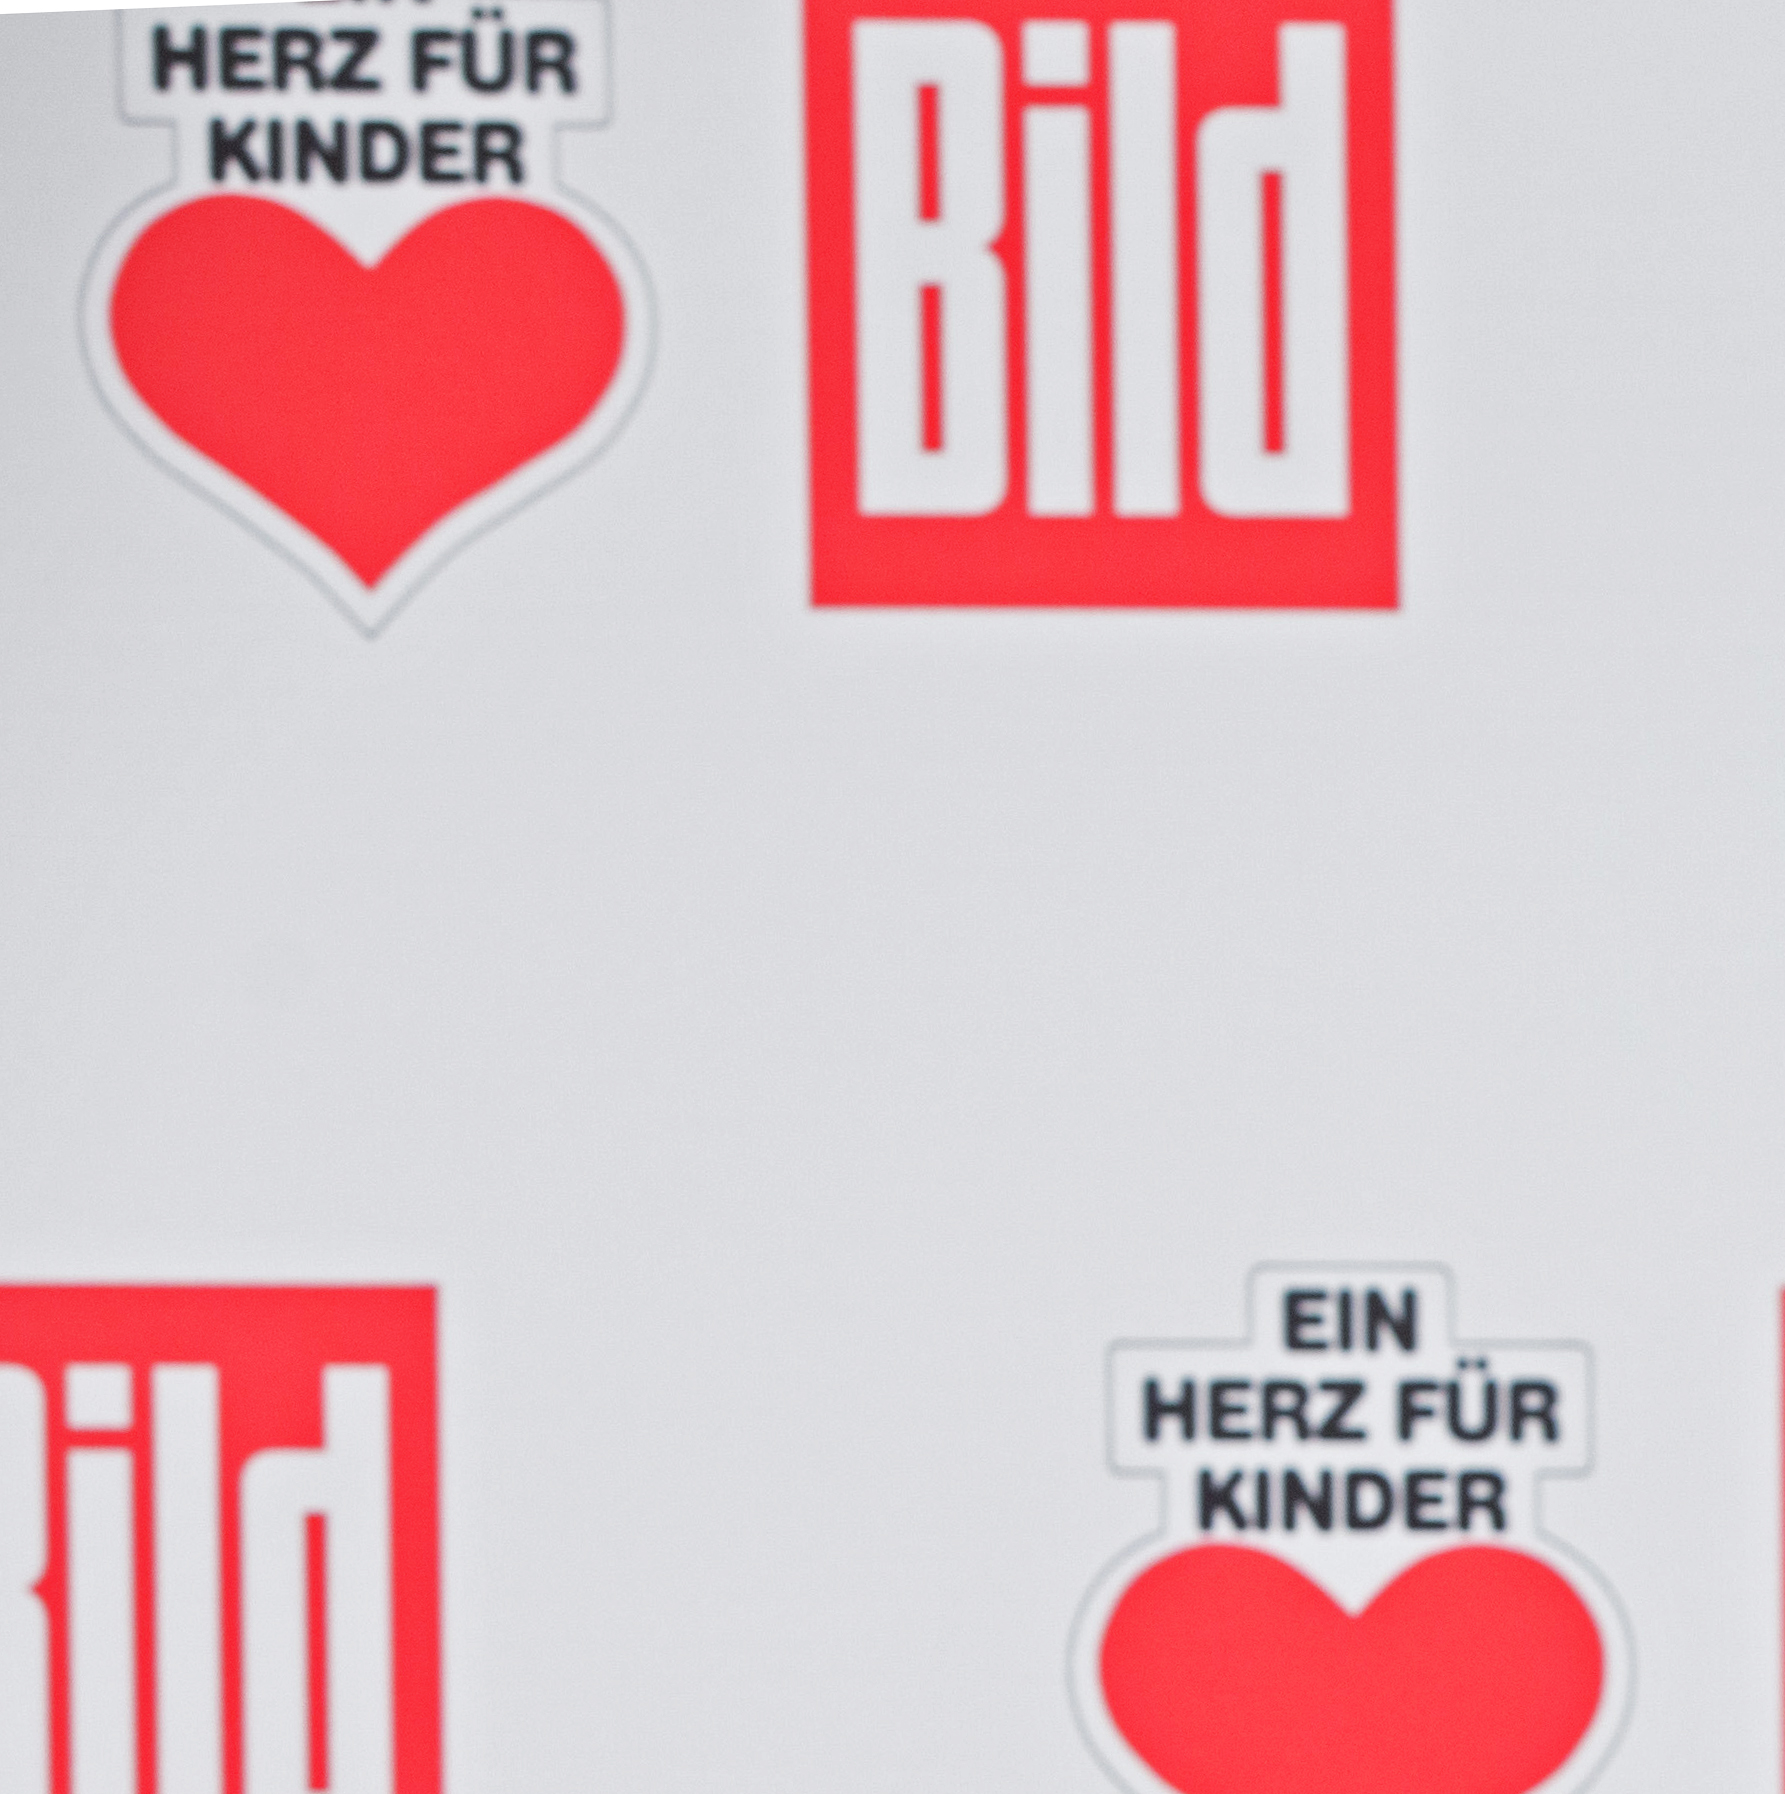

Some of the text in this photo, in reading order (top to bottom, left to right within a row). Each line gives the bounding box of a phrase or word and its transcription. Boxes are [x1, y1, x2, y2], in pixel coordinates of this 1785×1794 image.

[151, 6, 577, 95] HERZ FÜR
[208, 118, 525, 185] KINDER
[850, 18, 1352, 520] Bild
[1282, 1289, 1418, 1353] EIN
[1143, 1359, 1559, 1443] HERZ FÜR
[1198, 1470, 1507, 1533] KINDER
